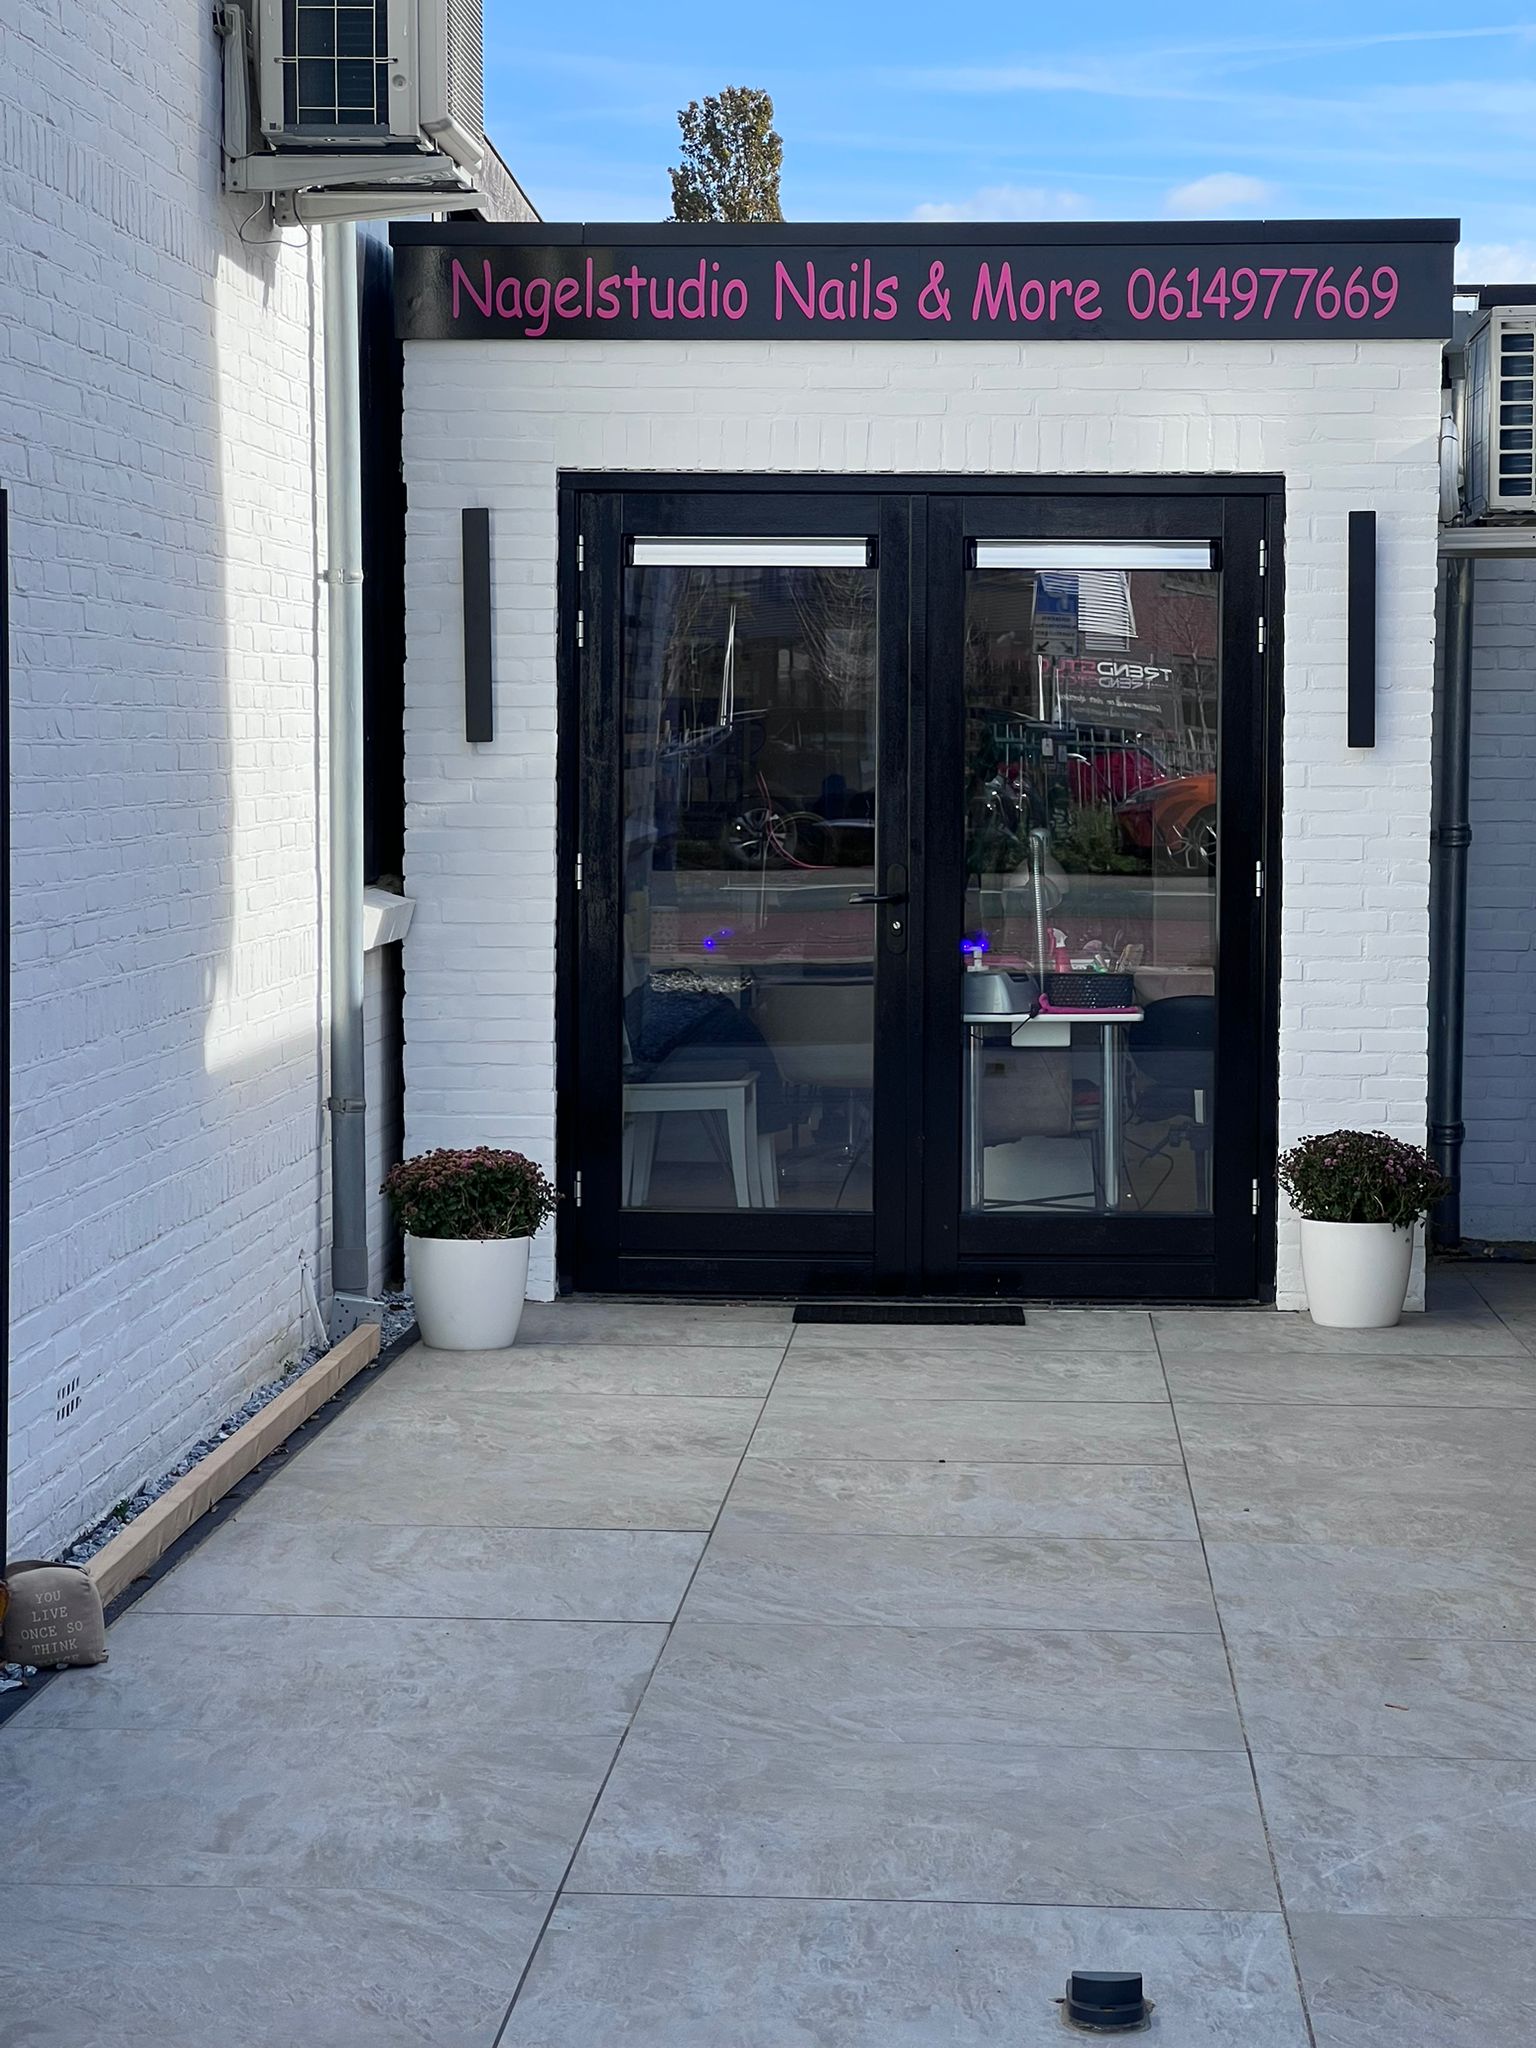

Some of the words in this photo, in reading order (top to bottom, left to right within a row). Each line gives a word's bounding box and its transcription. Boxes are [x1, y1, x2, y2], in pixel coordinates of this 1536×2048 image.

[451, 257, 749, 337] Nagelstudio
[774, 258, 899, 320] Nails
[917, 260, 951, 322] &
[971, 261, 1102, 322] More
[1127, 265, 1399, 320] 0614977669
[35, 1590, 61, 1604] YOU
[32, 1606, 68, 1622] LIVE
[21, 1625, 57, 1640] ONCE
[67, 1620, 83, 1634] SO
[31, 1638, 78, 1656] THINK
